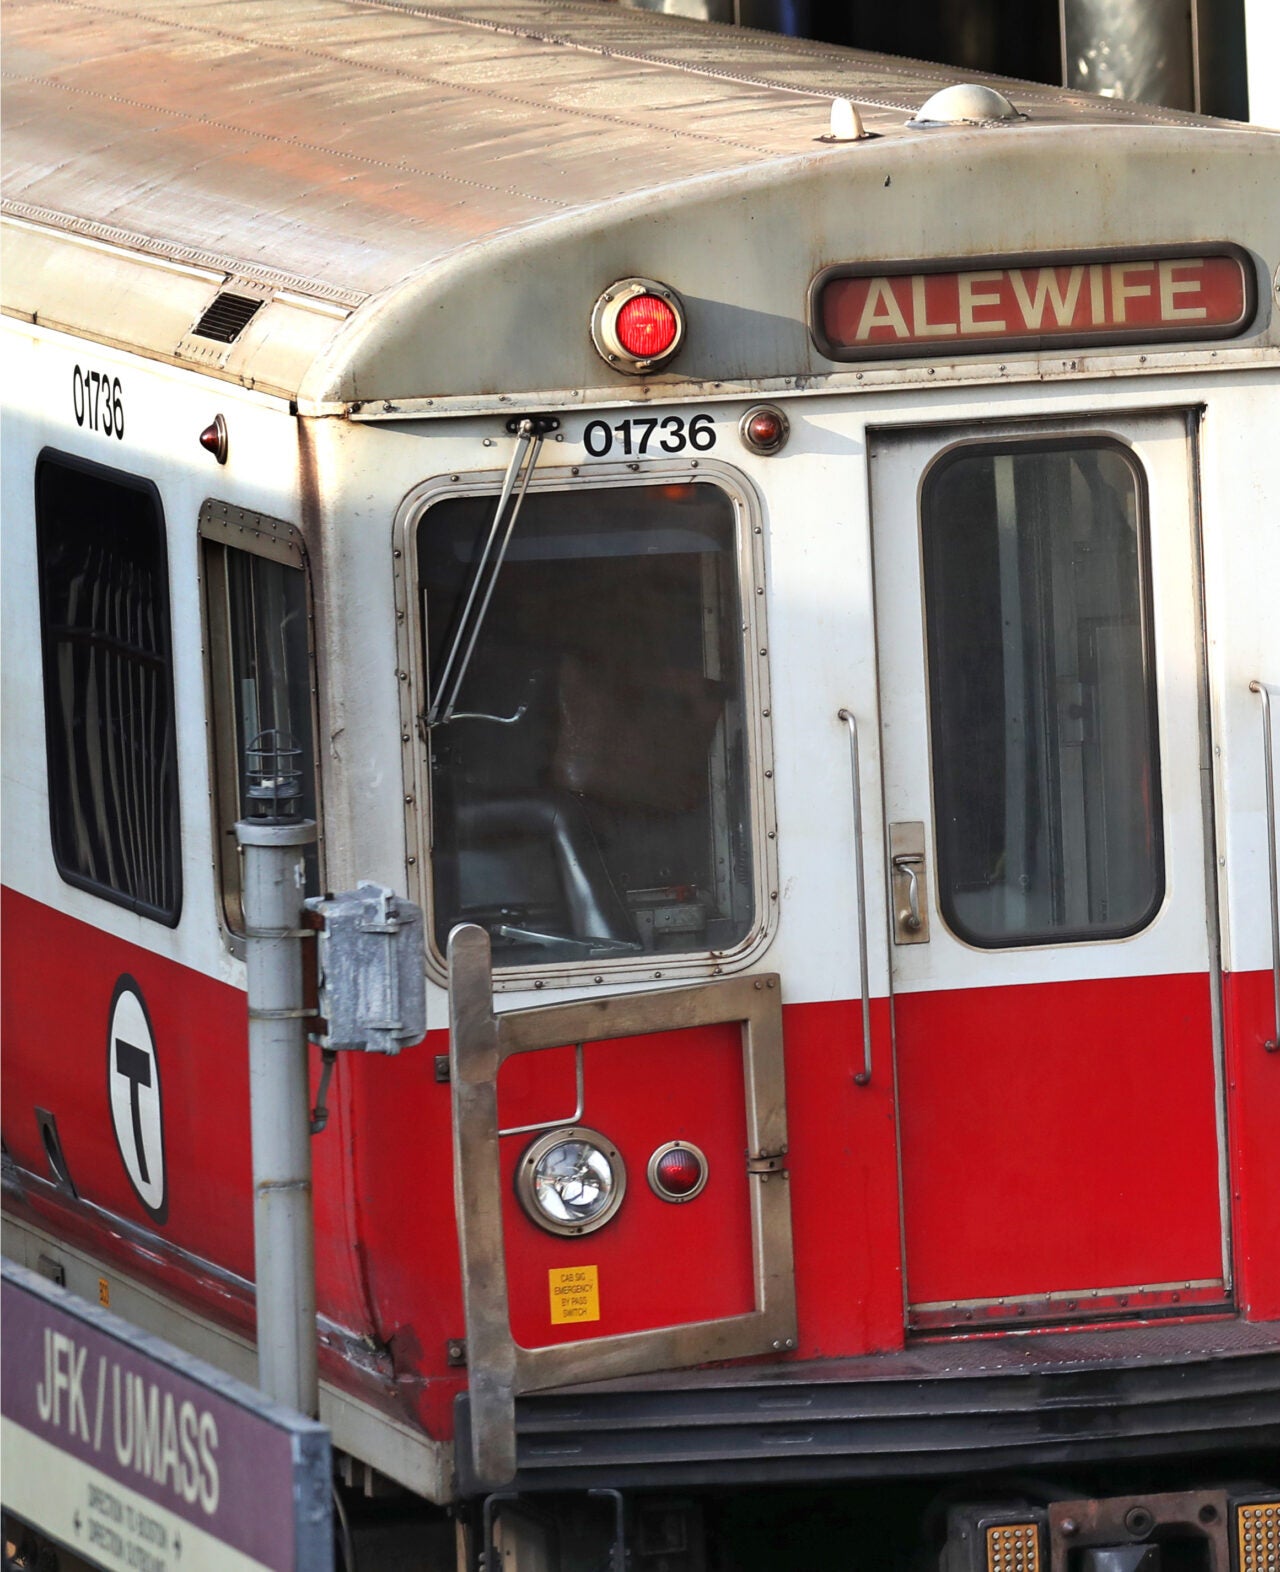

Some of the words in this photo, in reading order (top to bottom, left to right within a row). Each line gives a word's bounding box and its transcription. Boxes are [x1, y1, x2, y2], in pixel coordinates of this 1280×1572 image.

[855, 259, 1207, 341] ALEWIFE
[73, 364, 124, 440] 01736
[583, 414, 717, 457] 01736
[115, 1037, 151, 1184] T
[554, 1283, 593, 1295] EMERGENCY
[563, 1308, 587, 1318] SWITCH
[571, 1296, 588, 1305] PASS
[36, 1327, 90, 1443] JFK
[112, 1364, 220, 1514] UMASS
